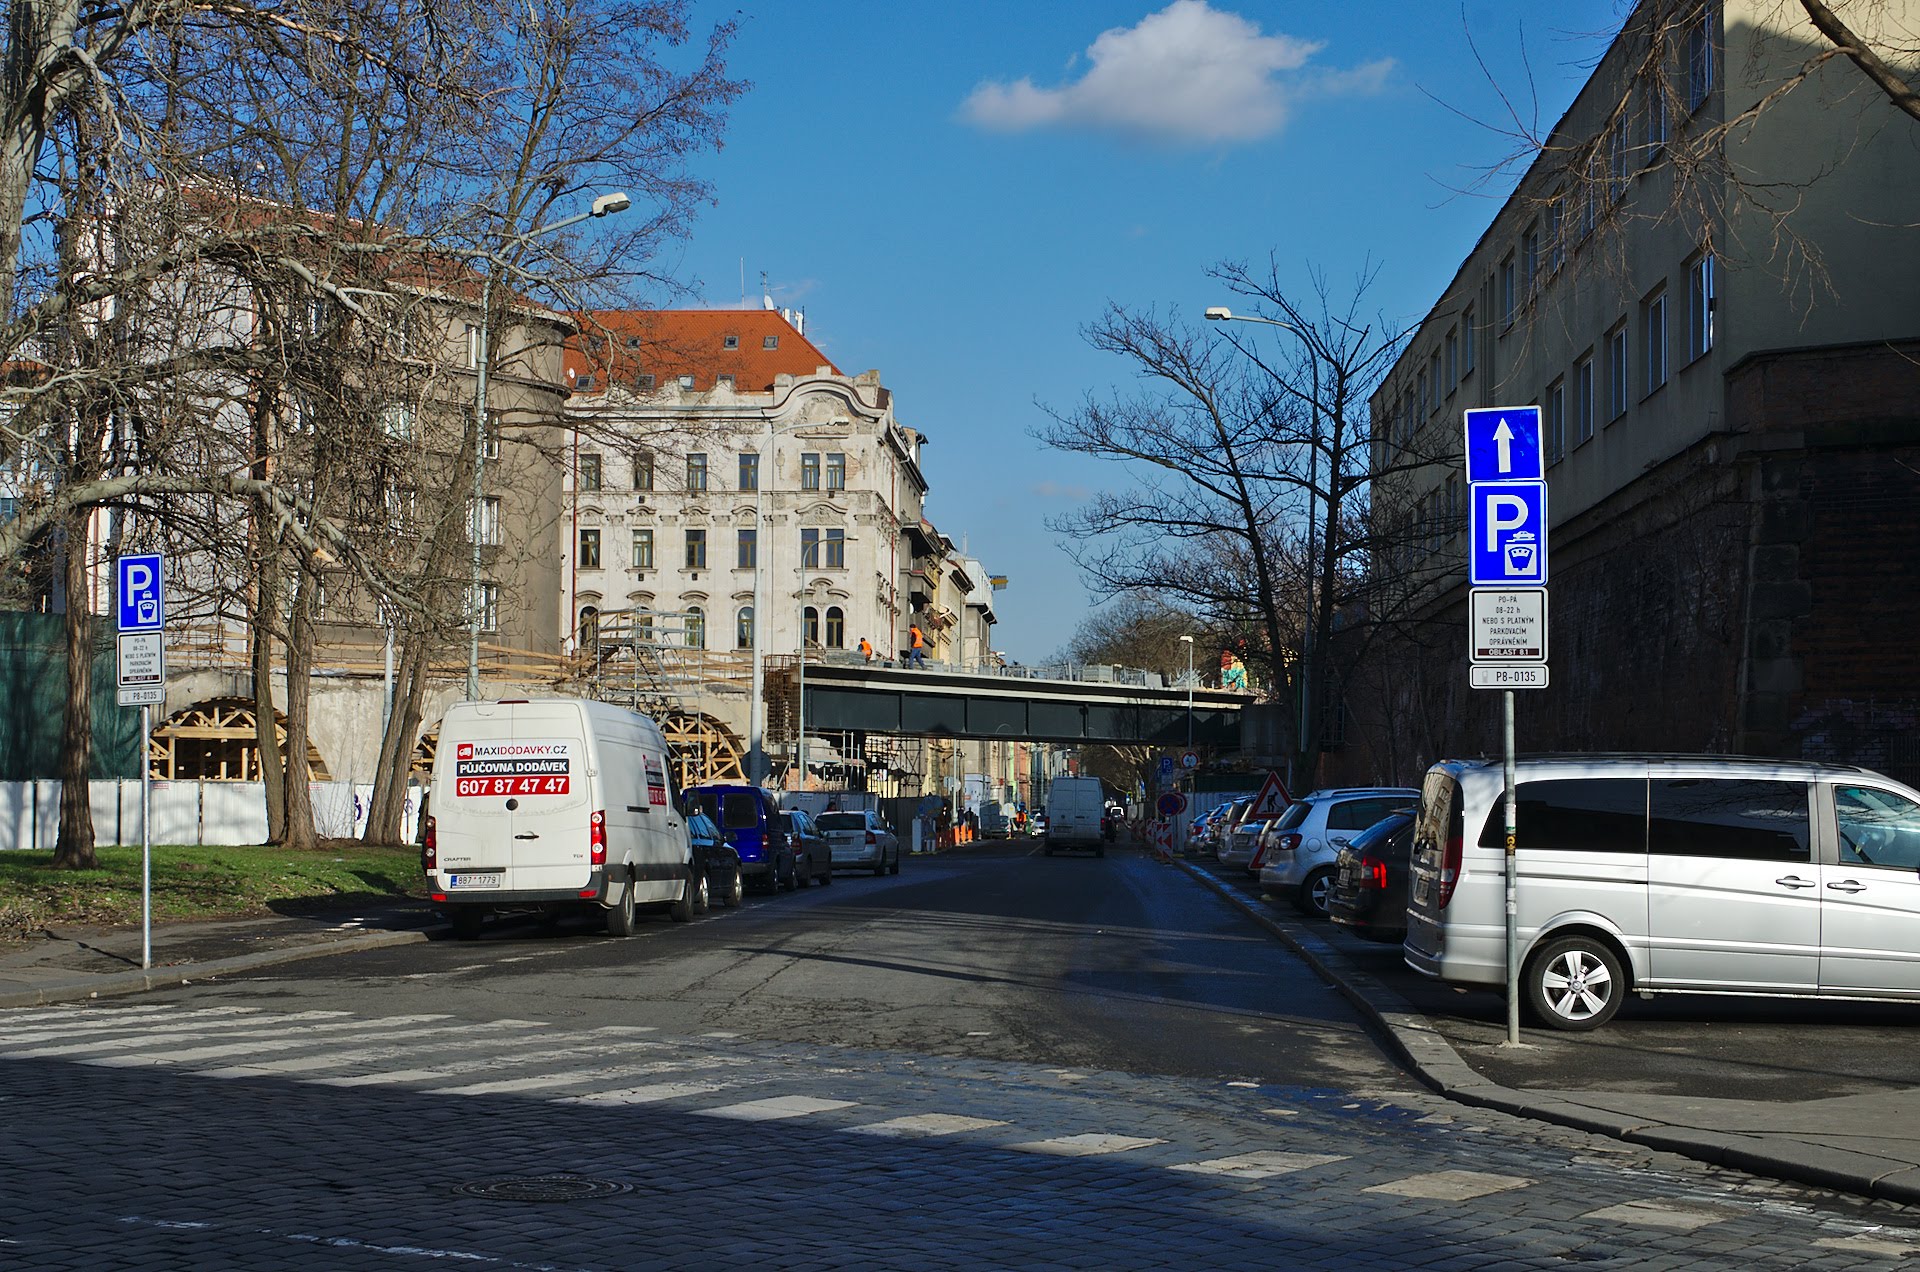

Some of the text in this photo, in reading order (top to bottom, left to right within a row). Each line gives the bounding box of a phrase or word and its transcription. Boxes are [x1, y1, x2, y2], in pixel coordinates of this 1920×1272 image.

[1487, 494, 1529, 553] P
[127, 564, 153, 607] P
[1495, 606, 1514, 614] 08-22
[1507, 615, 1534, 624] PLATNÝM
[1489, 626, 1527, 635] PARKOVACÍM
[1489, 636, 1528, 645] OPRÁVNĚNÍM
[1488, 648, 1516, 656] OBLAST
[1496, 671, 1536, 682] P8-0135
[133, 691, 157, 700] P8-0135
[474, 745, 567, 756] MAXIDODAVKY.CZ
[460, 760, 567, 774] PŮJČOVNA DODÁVEK
[459, 778, 567, 795] 607 87 47 47
[478, 876, 497, 884] 1779
